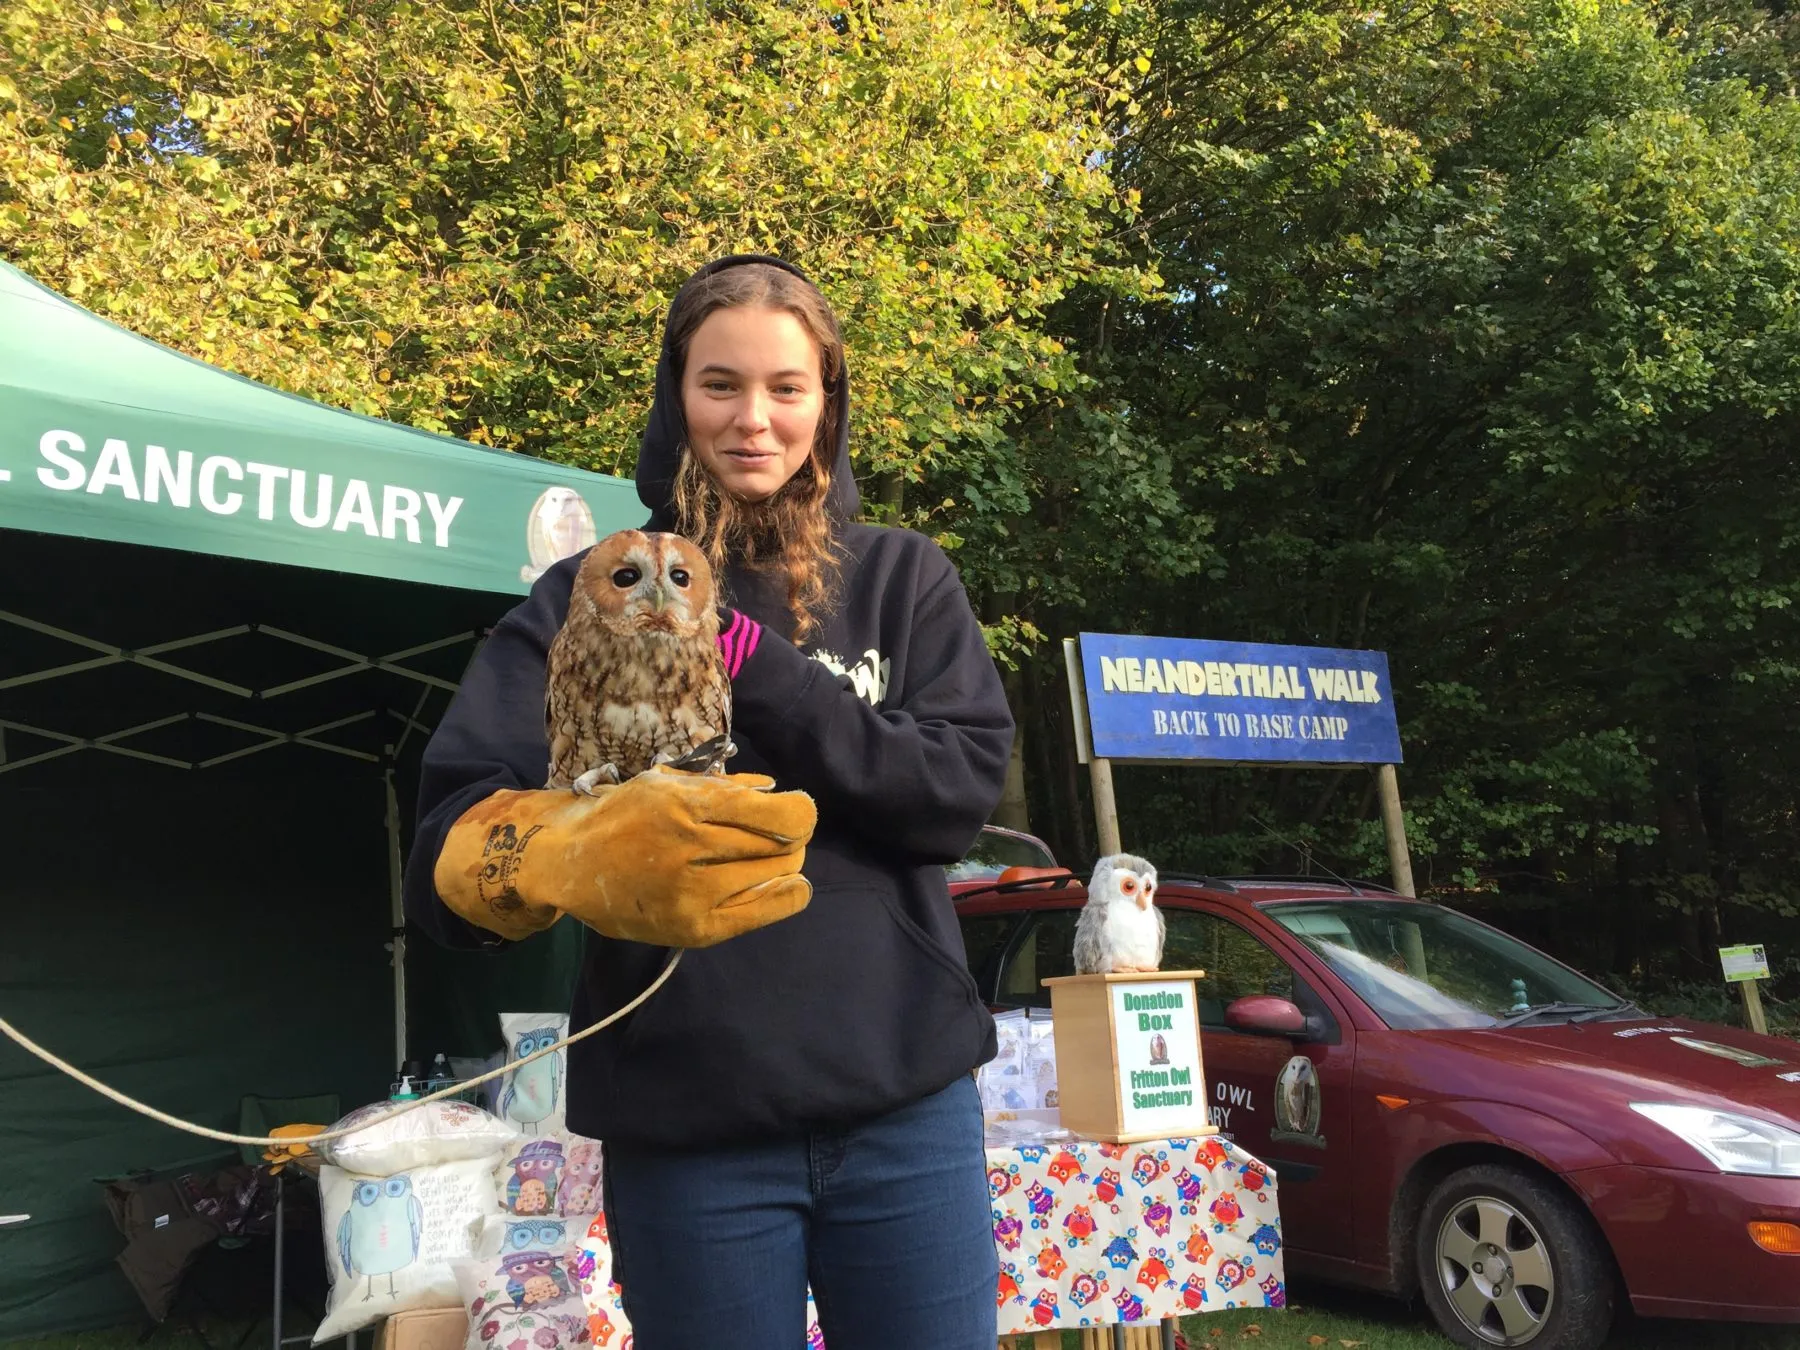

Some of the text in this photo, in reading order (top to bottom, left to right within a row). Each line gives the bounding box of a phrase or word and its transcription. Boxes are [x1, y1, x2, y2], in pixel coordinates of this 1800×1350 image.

[37, 429, 464, 548] SANCTUARY
[1099, 655, 1382, 704] NEANDERTHAL WALK
[1152, 709, 1349, 741] BACK TO BASE CAMP
[1124, 991, 1183, 1011] Donation
[1138, 1012, 1173, 1032] Box
[1131, 1067, 1191, 1089] Fritton Owl
[1133, 1090, 1192, 1109] Sanctuary
[1216, 1082, 1255, 1112] OWL
[1207, 1105, 1232, 1129] ARY
